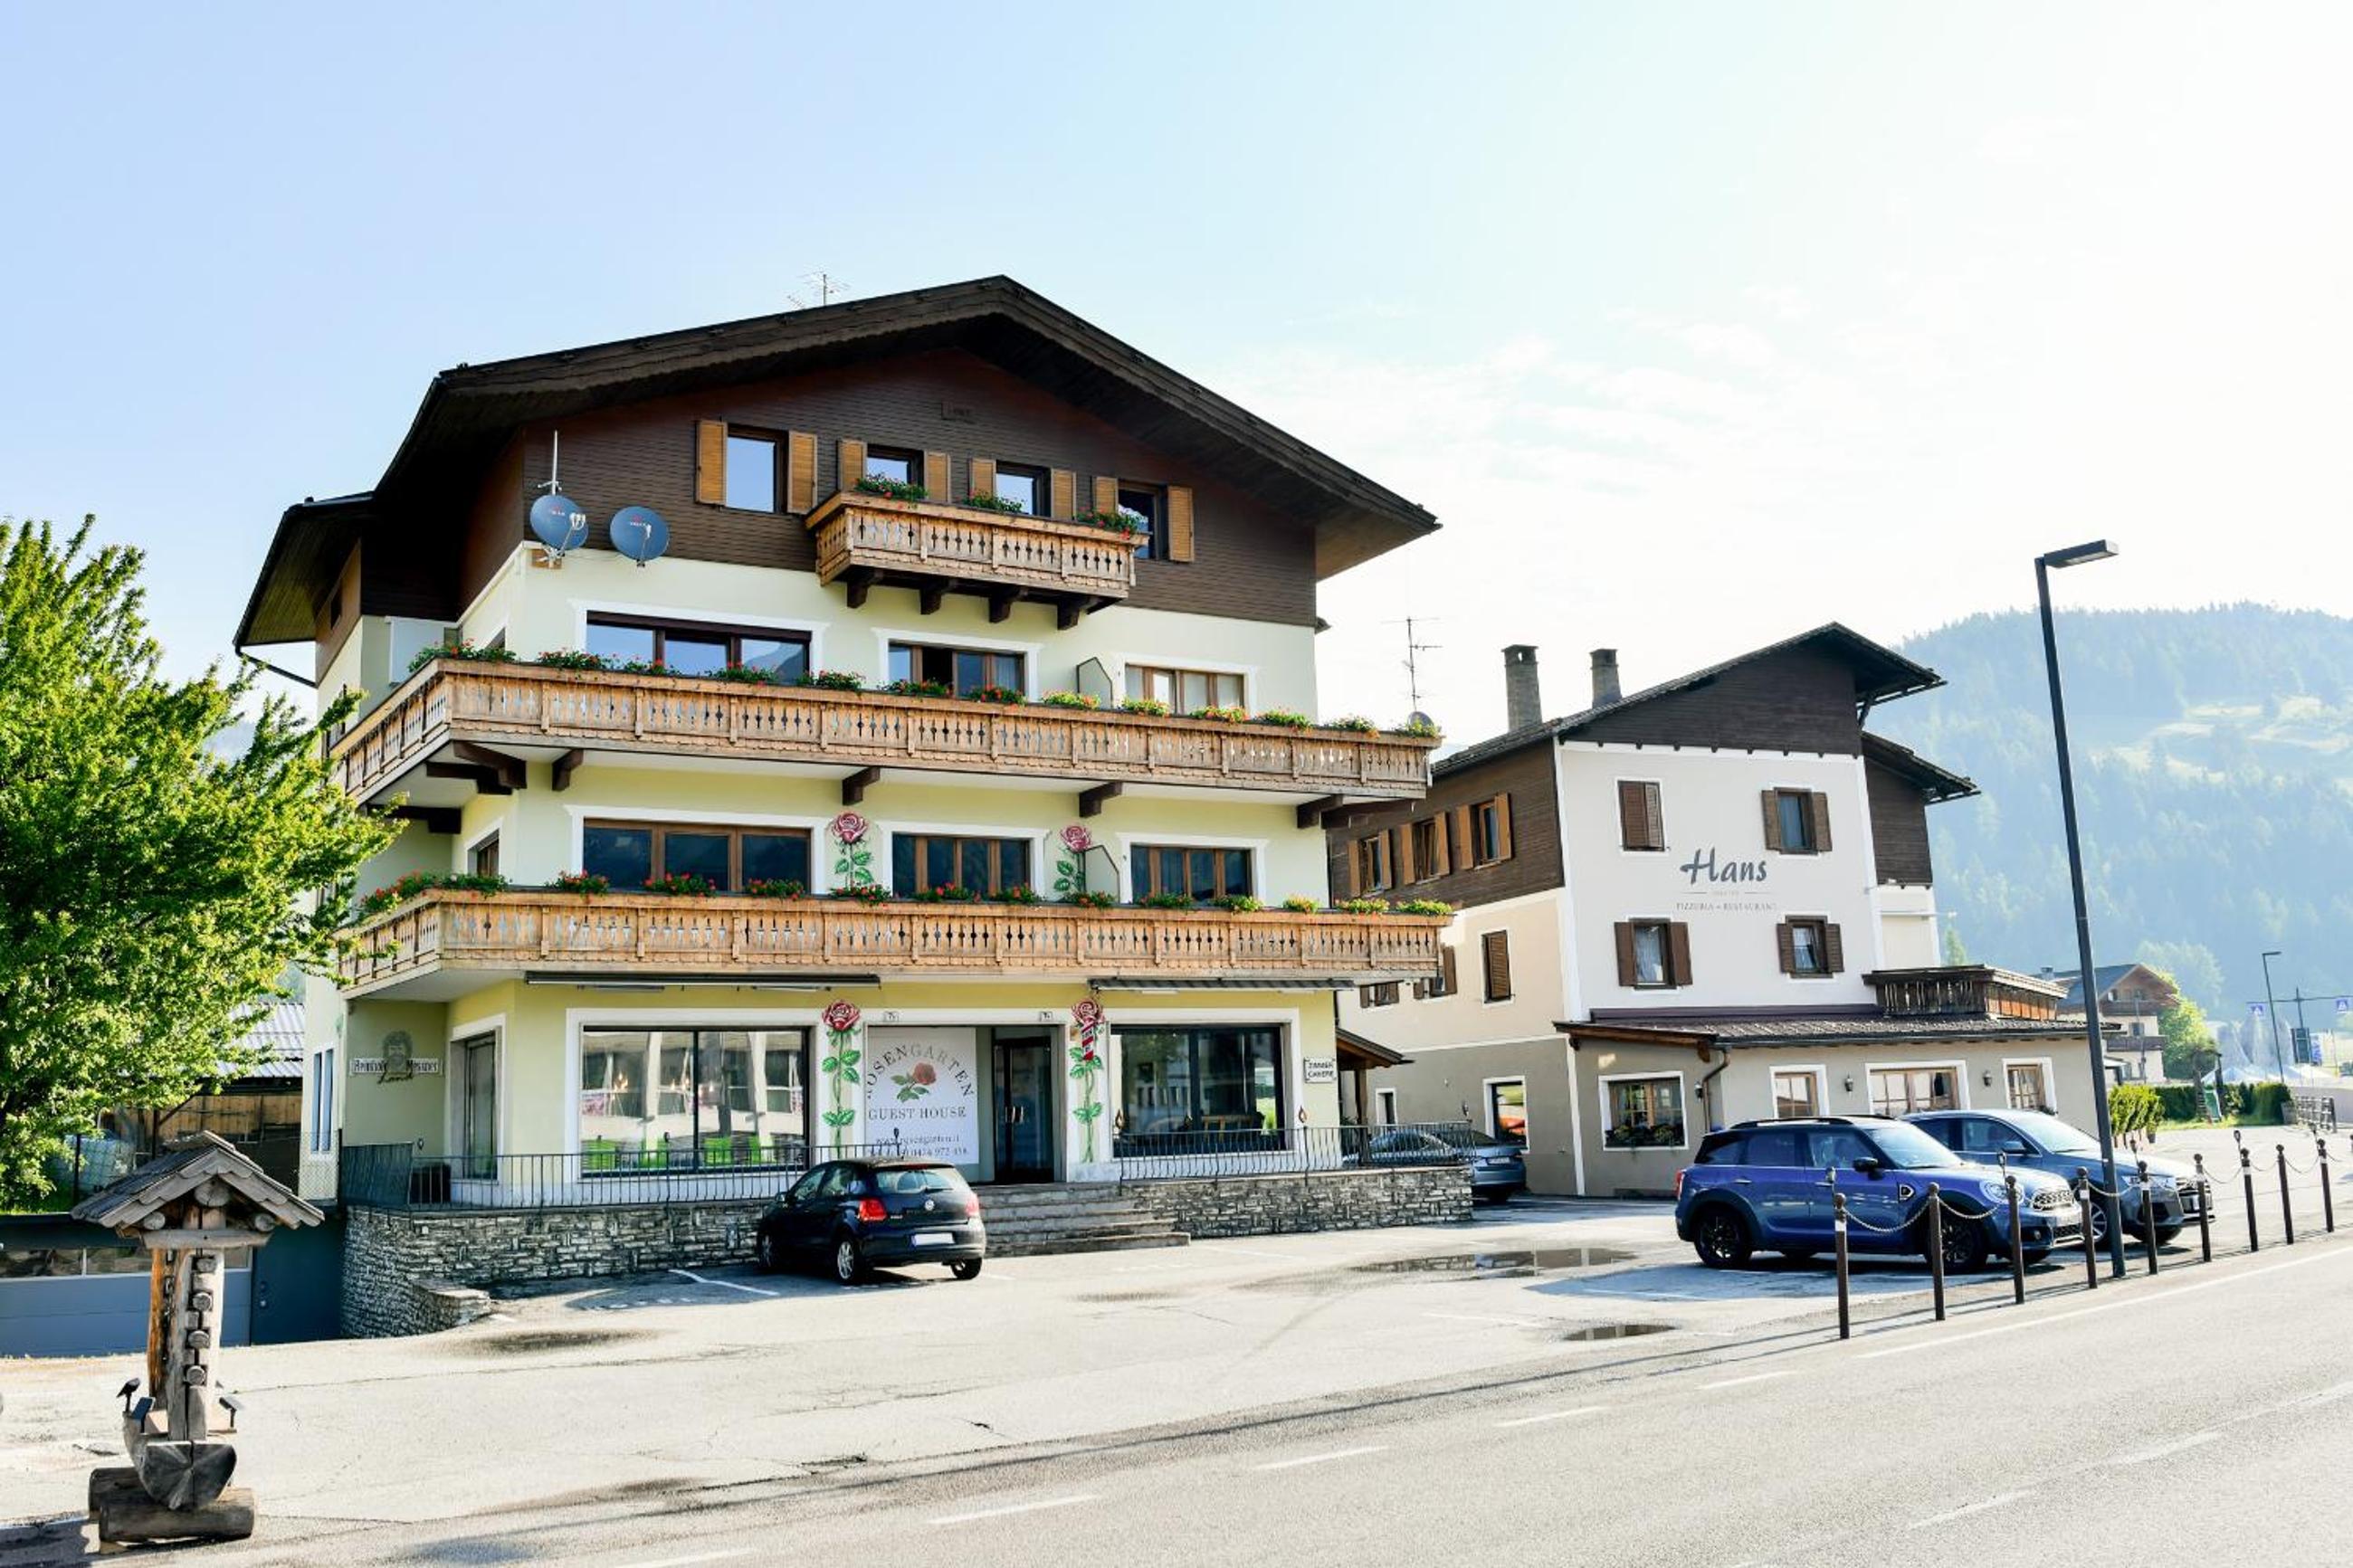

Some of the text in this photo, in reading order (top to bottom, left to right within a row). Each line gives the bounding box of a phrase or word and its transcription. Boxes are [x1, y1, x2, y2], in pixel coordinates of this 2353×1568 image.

[1680, 847, 1767, 885] Hans
[868, 1107, 967, 1120] GUEST HOUSE
